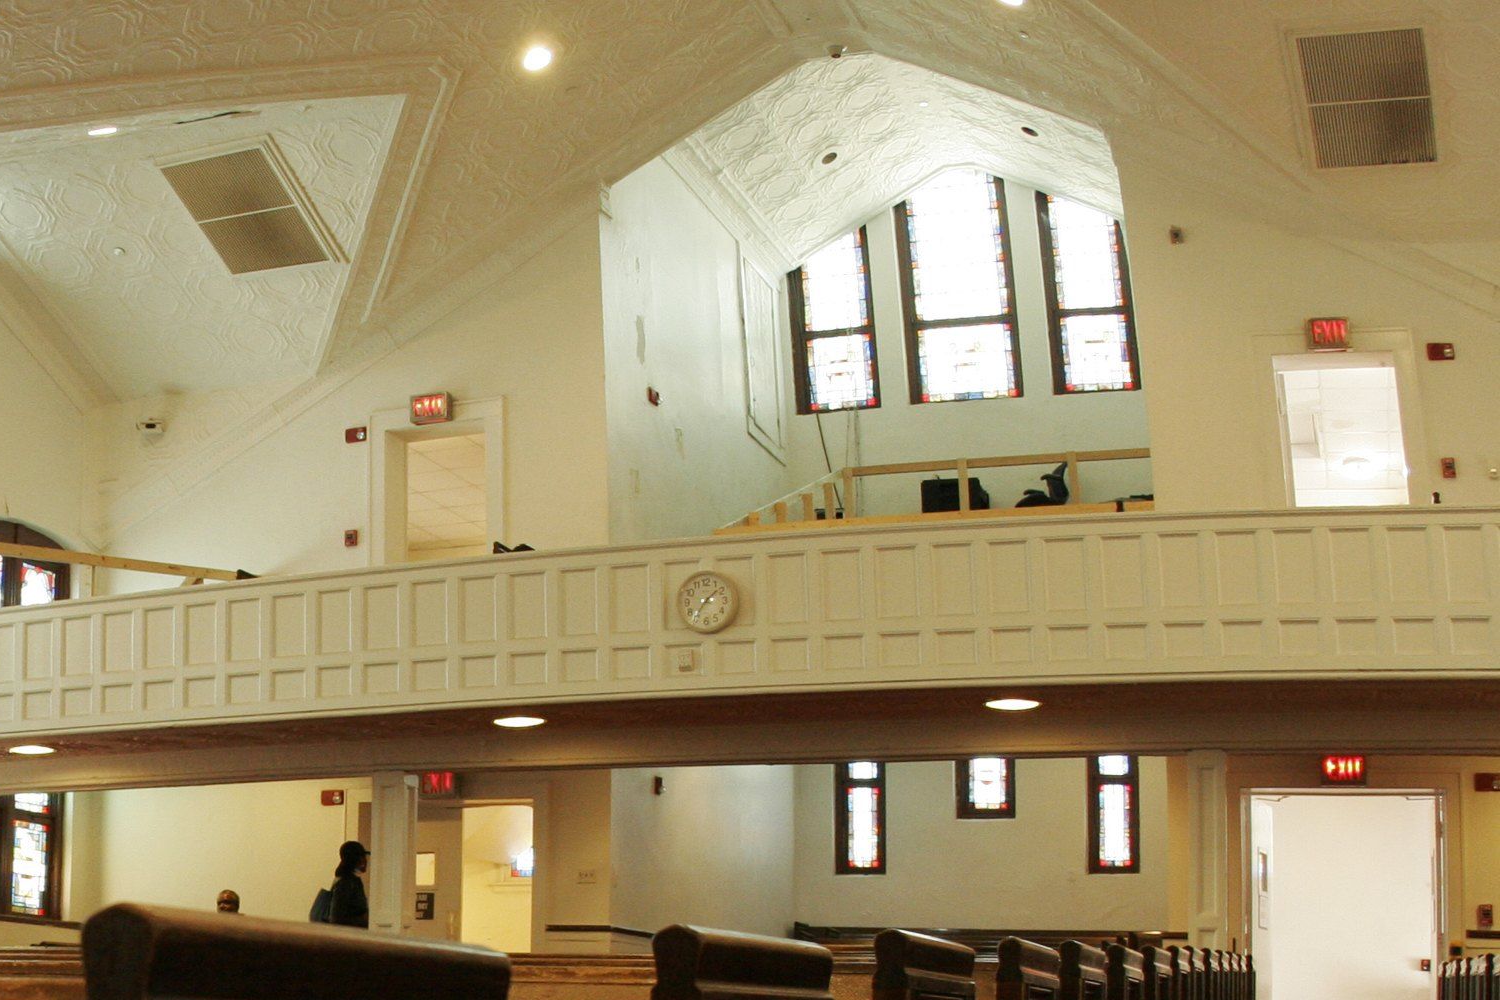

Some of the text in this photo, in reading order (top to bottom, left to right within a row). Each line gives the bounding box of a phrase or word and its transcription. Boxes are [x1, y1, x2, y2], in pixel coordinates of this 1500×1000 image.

[1313, 320, 1346, 343] EXIT
[413, 396, 446, 417] EXIT
[1325, 756, 1363, 779] EXIT
[423, 771, 453, 793] EXIT
